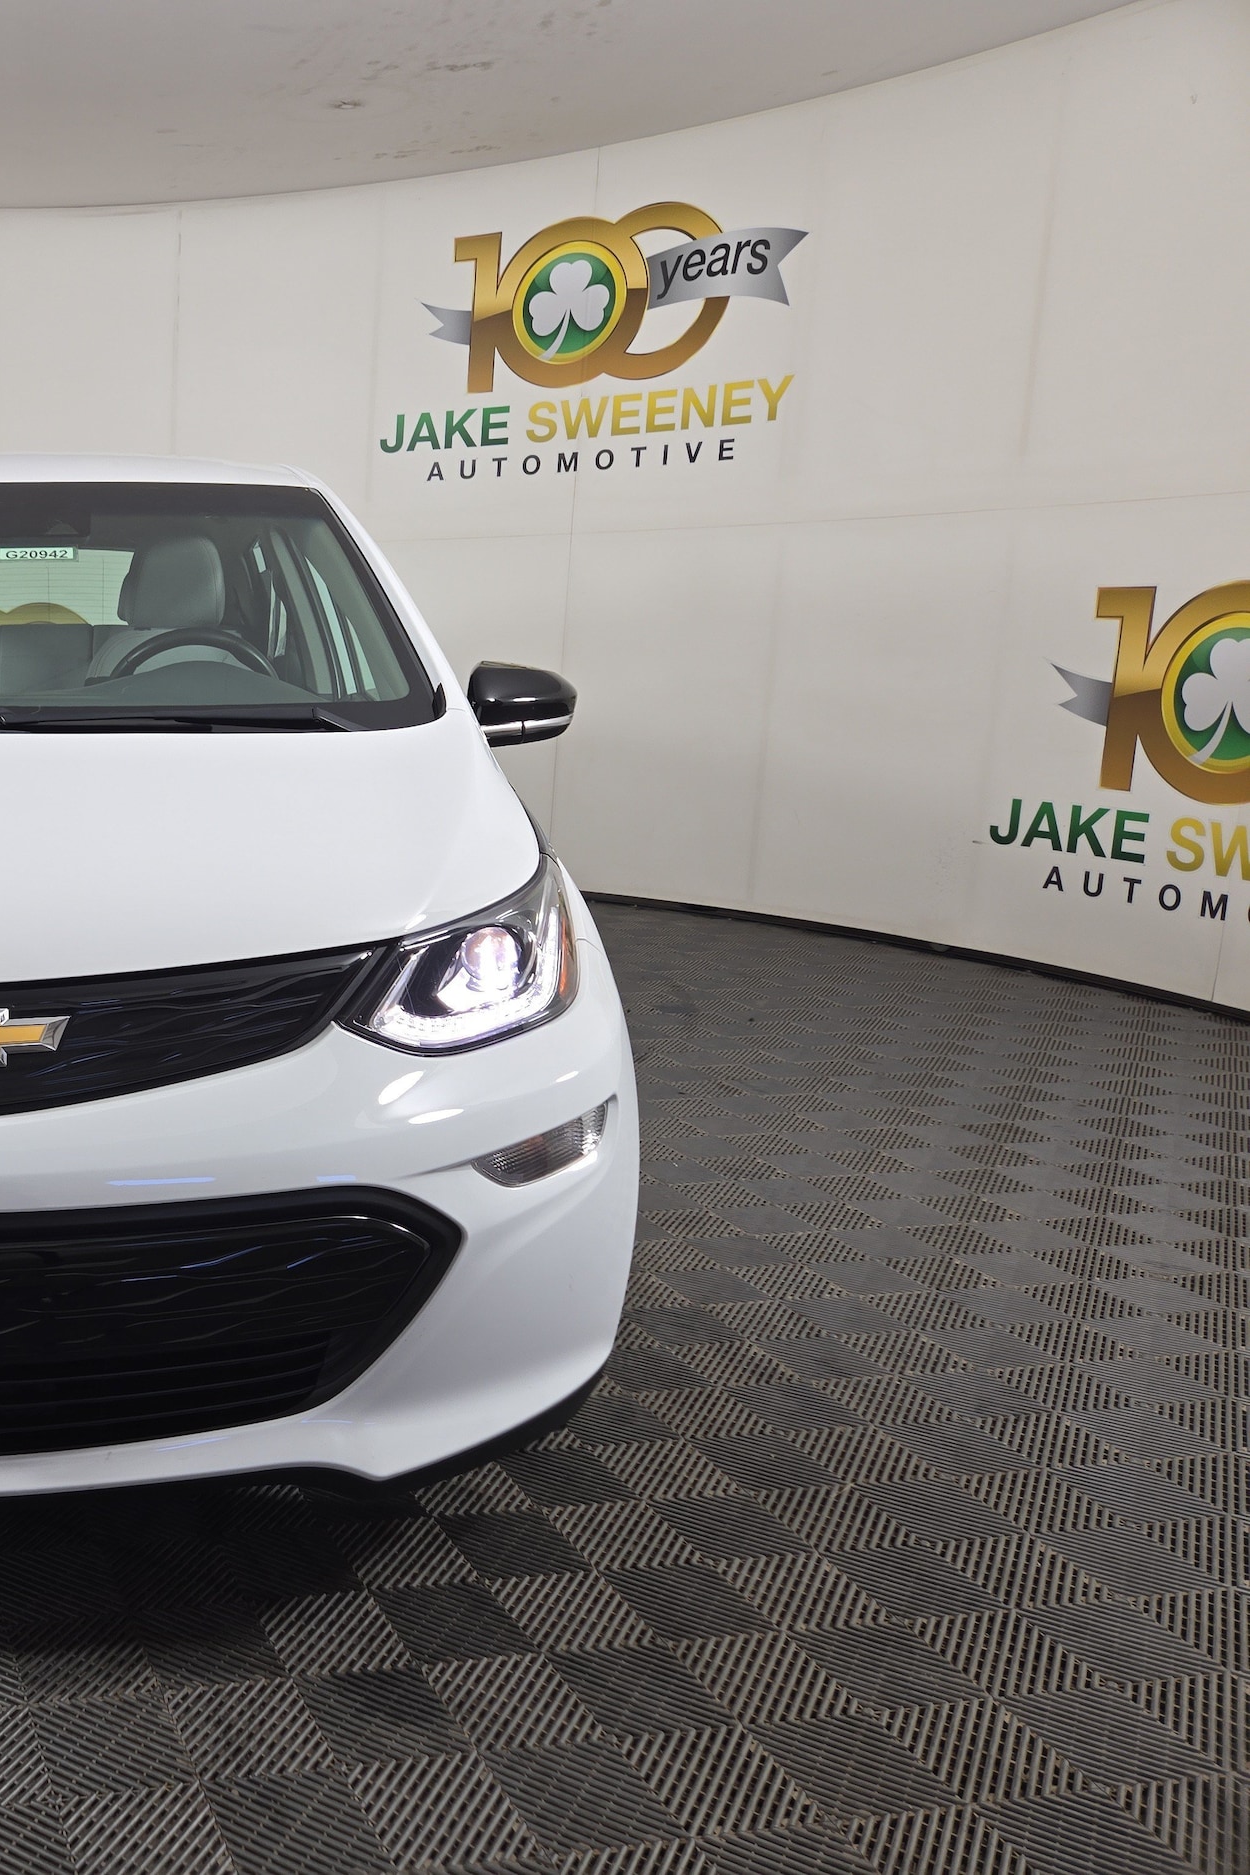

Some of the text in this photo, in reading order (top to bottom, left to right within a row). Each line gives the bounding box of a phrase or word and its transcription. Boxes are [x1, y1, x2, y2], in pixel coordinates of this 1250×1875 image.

[454, 201, 771, 394] 100 years
[380, 374, 795, 454] JAKE SWEENEY
[427, 439, 735, 482] AUTOMOTIVE
[5, 549, 69, 560] G20942
[990, 798, 1150, 864] JAKE
[1043, 866, 1250, 927] AUTOM
